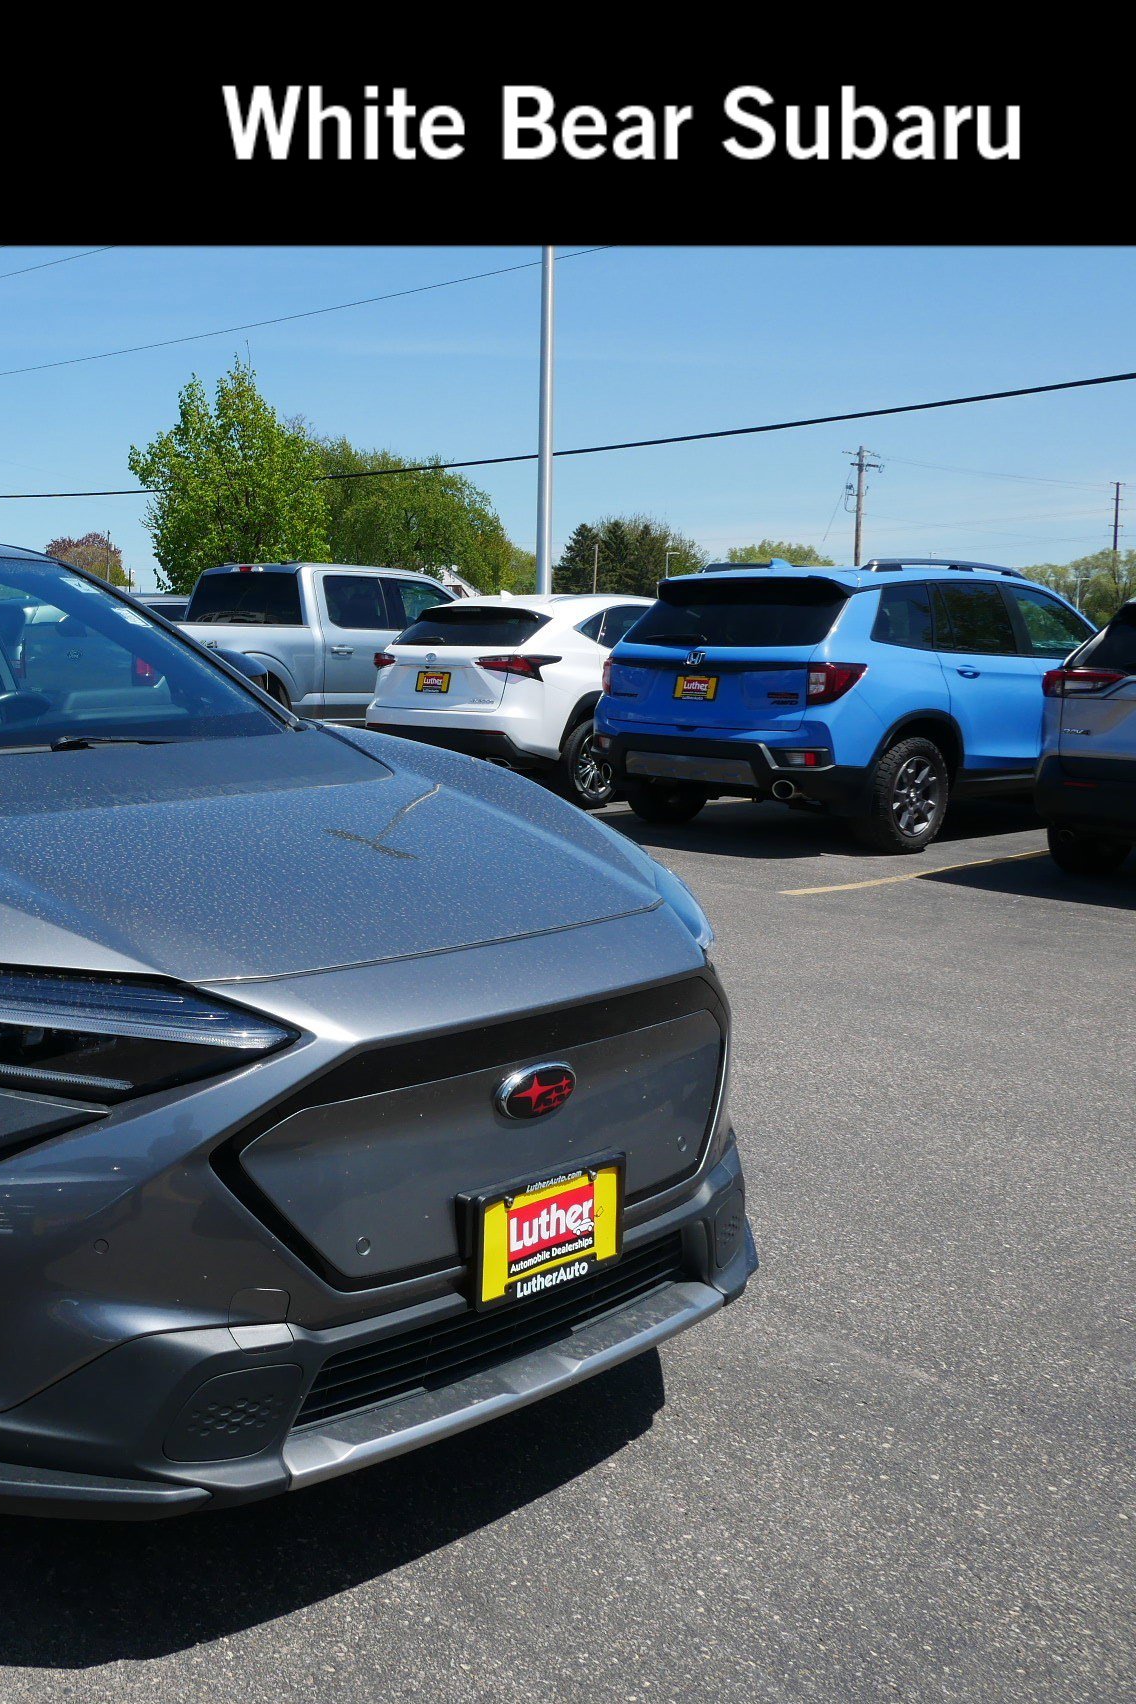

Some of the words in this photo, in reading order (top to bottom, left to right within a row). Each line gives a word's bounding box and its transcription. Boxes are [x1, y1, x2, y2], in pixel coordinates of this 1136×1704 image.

[423, 676, 443, 685] Luther
[683, 680, 709, 691] Luther
[526, 1170, 582, 1193] LutherAuto.com
[510, 1198, 593, 1252] Luther
[509, 1250, 551, 1274] Automobile
[551, 1236, 593, 1257] Dealerships
[516, 1260, 589, 1299] LutherAuto
